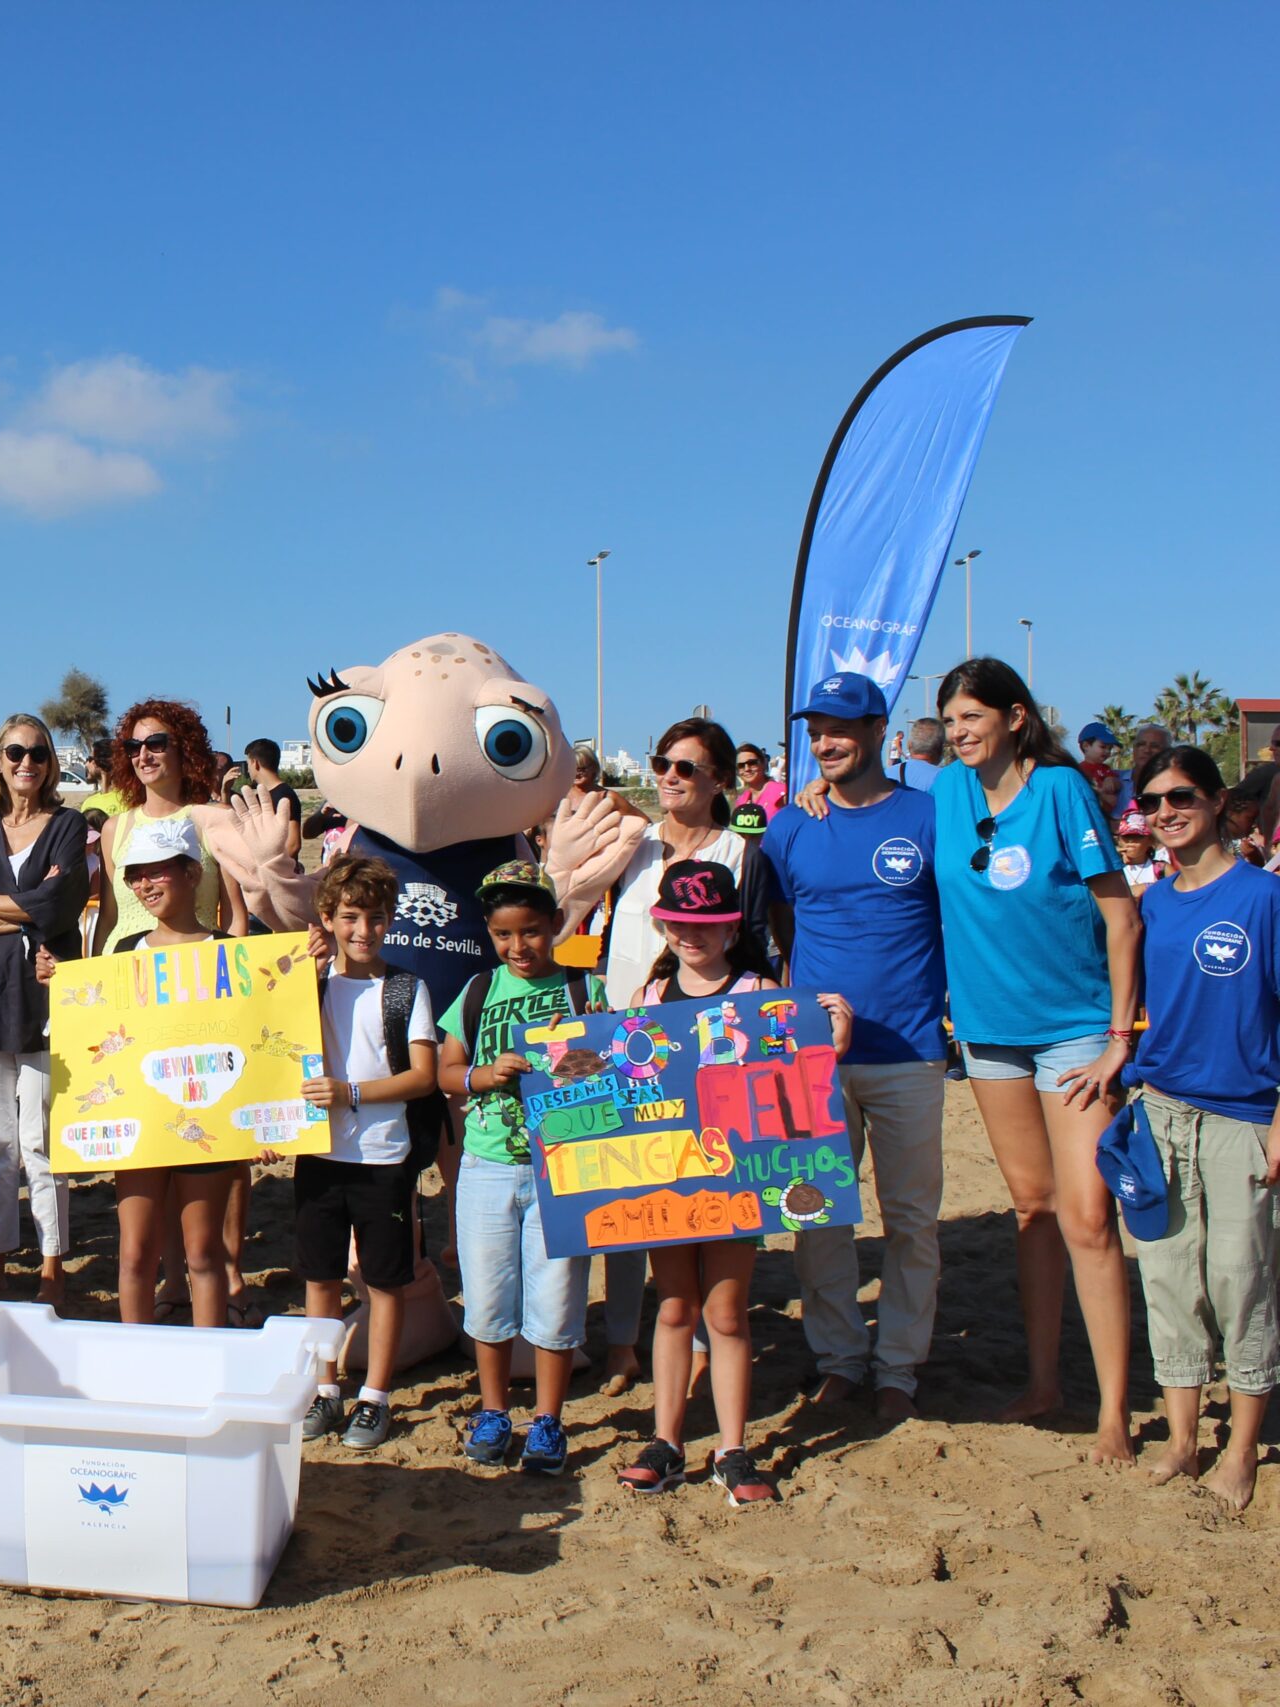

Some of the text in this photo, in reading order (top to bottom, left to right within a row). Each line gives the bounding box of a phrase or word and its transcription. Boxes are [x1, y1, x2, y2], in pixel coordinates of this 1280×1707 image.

[736, 814, 760, 827] BOY
[413, 932, 431, 949] de
[435, 936, 482, 956] Sevilla
[1204, 930, 1245, 940] FUNDACIÓN
[115, 943, 253, 1010] HUELLAS
[1203, 964, 1233, 972] VALENCIA
[145, 1018, 240, 1044] DESEAMOS
[524, 999, 798, 1085] TOBI
[152, 1051, 235, 1080] QUE VIVA MUCHOS
[183, 1077, 208, 1102] AÑOS
[531, 1077, 662, 1113] DESEAMOS SEAS
[540, 1101, 618, 1140] QUE
[635, 1100, 684, 1122] MUY
[699, 1047, 846, 1142] FELIZ
[239, 1109, 262, 1126] QUE
[263, 1107, 285, 1123] SEA
[286, 1105, 304, 1121] MU
[67, 1122, 136, 1142] QUE FORME SU
[262, 1124, 292, 1141] FELIZ
[83, 1142, 122, 1156] FAMILIA
[536, 1128, 855, 1192] Y TENGAS MUCHOS
[596, 1191, 758, 1241] AMIGOS
[81, 1459, 126, 1468] FUNDACIÓN
[81, 1521, 127, 1529] VALENCIA
